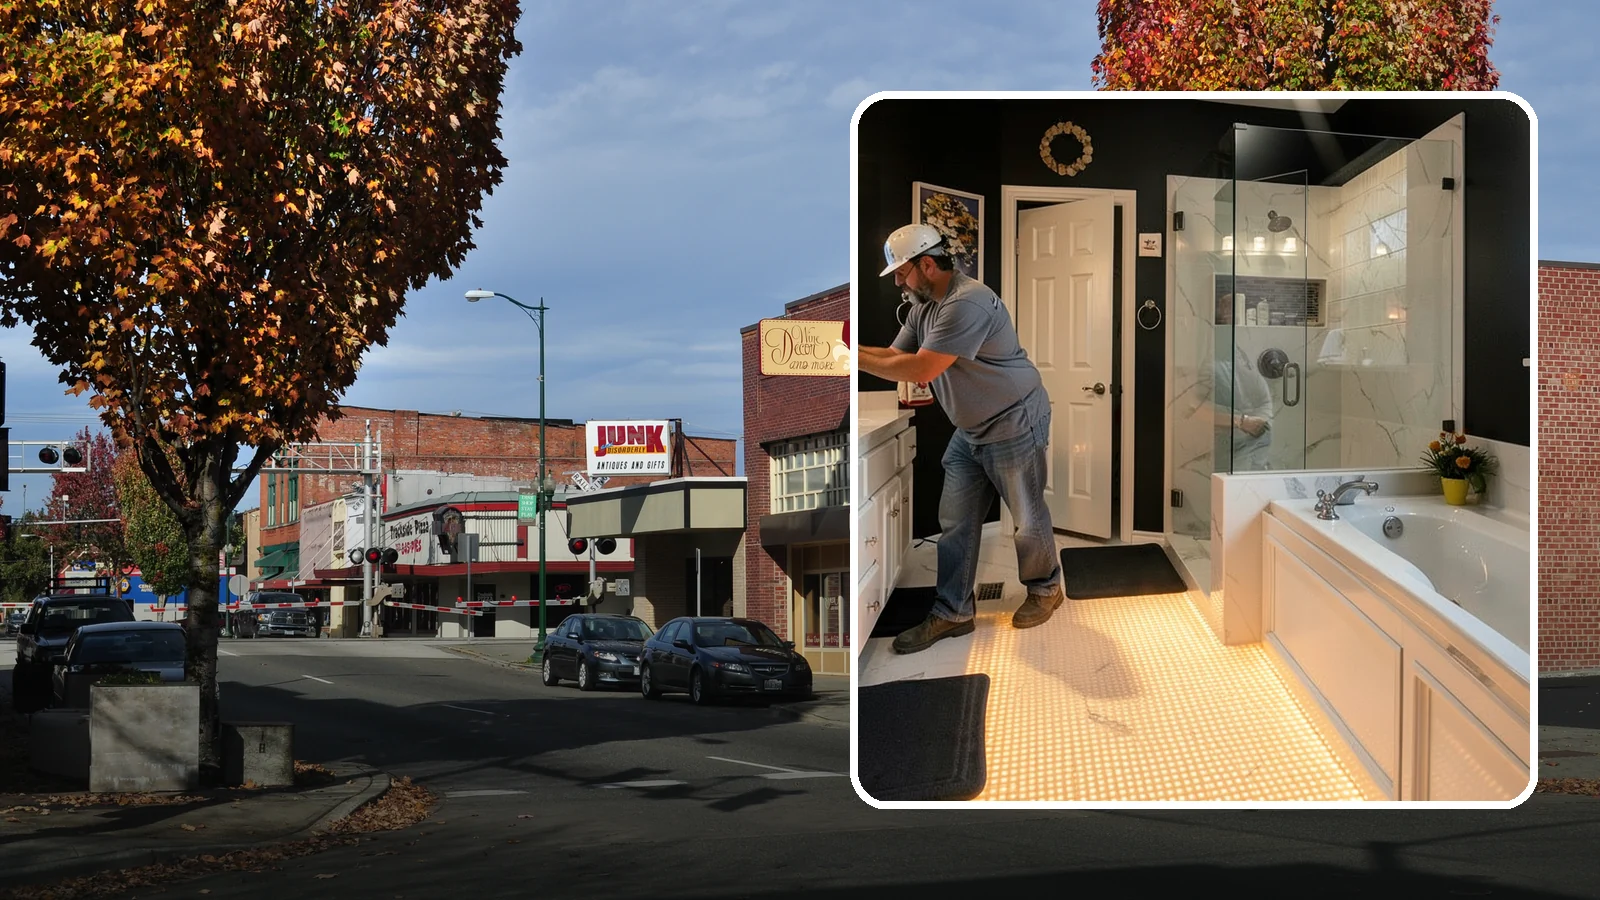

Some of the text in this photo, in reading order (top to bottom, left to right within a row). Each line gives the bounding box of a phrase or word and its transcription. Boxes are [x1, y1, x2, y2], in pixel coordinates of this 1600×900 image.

[595, 425, 665, 457] JUNK
[607, 446, 646, 454] DISORDERLY
[597, 460, 665, 470] ANTIQUES AND GIFTS
[415, 519, 429, 535] Pizza
